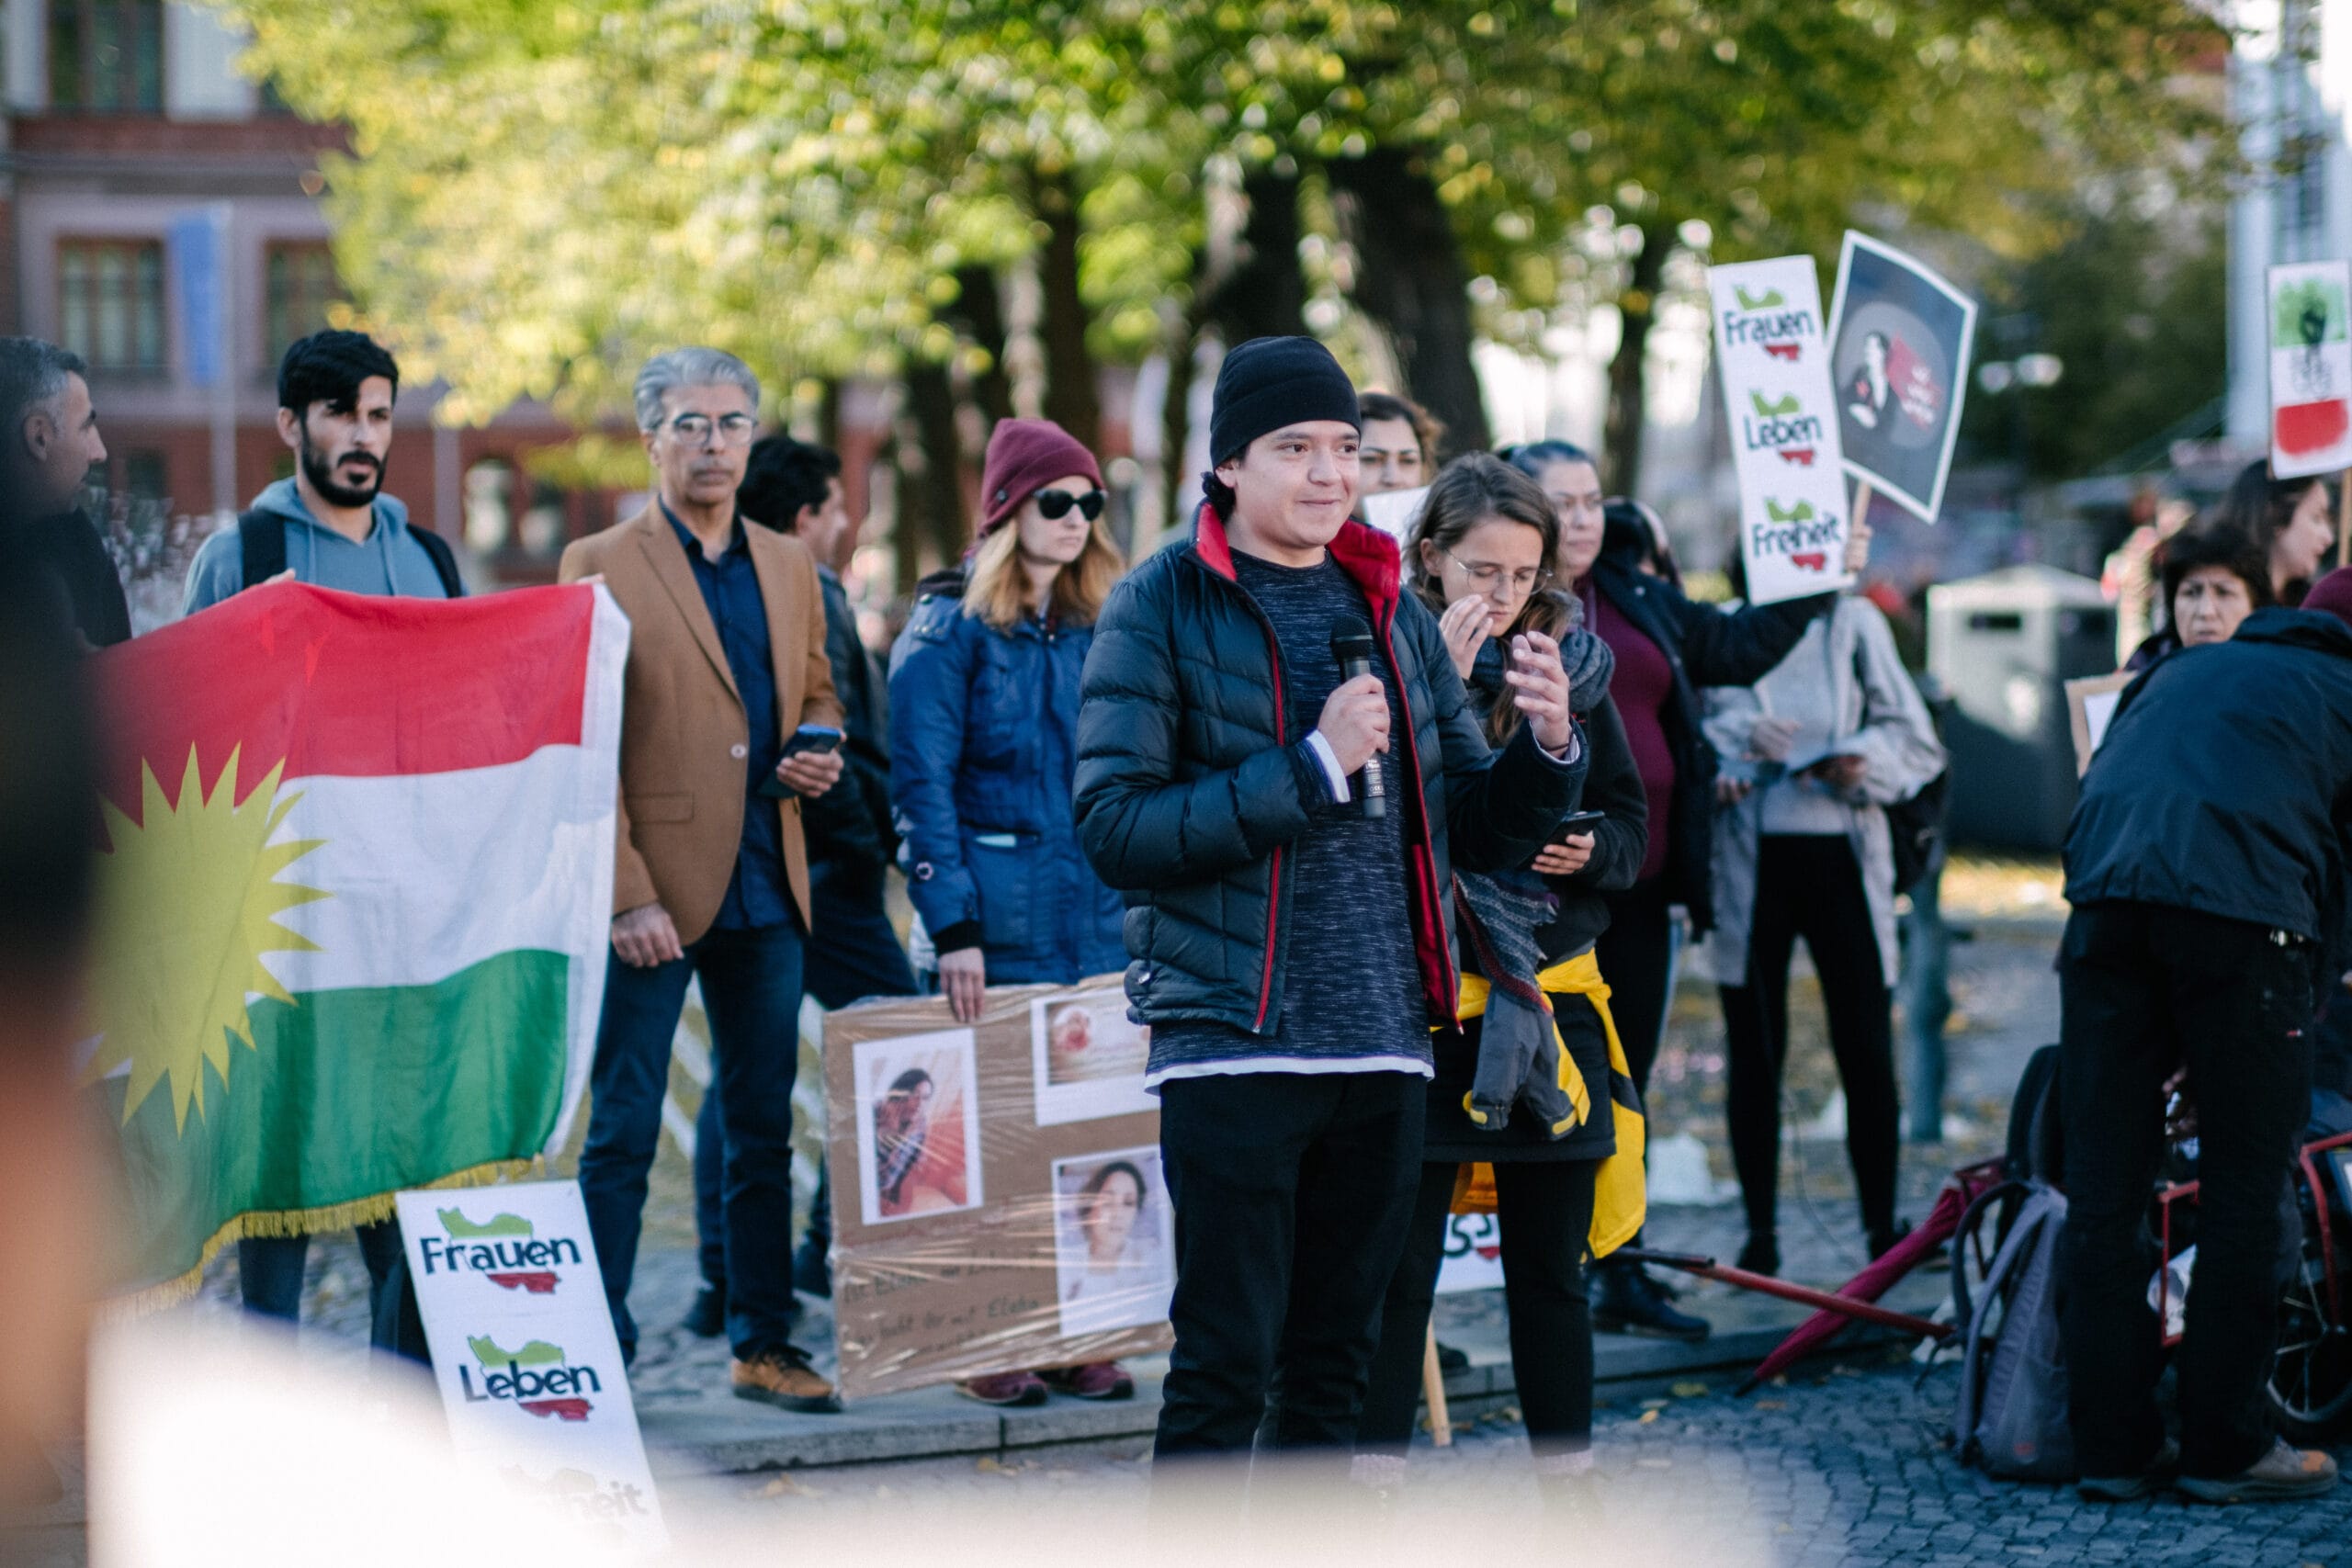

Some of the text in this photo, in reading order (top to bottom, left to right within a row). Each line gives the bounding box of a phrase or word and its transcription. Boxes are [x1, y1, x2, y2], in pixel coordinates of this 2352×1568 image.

[1724, 310, 1815, 346] Frauen
[1743, 412, 1823, 450] Leben
[1751, 512, 1841, 557] Freiheit
[419, 1235, 582, 1275] Frauen
[458, 1360, 602, 1403] Leben
